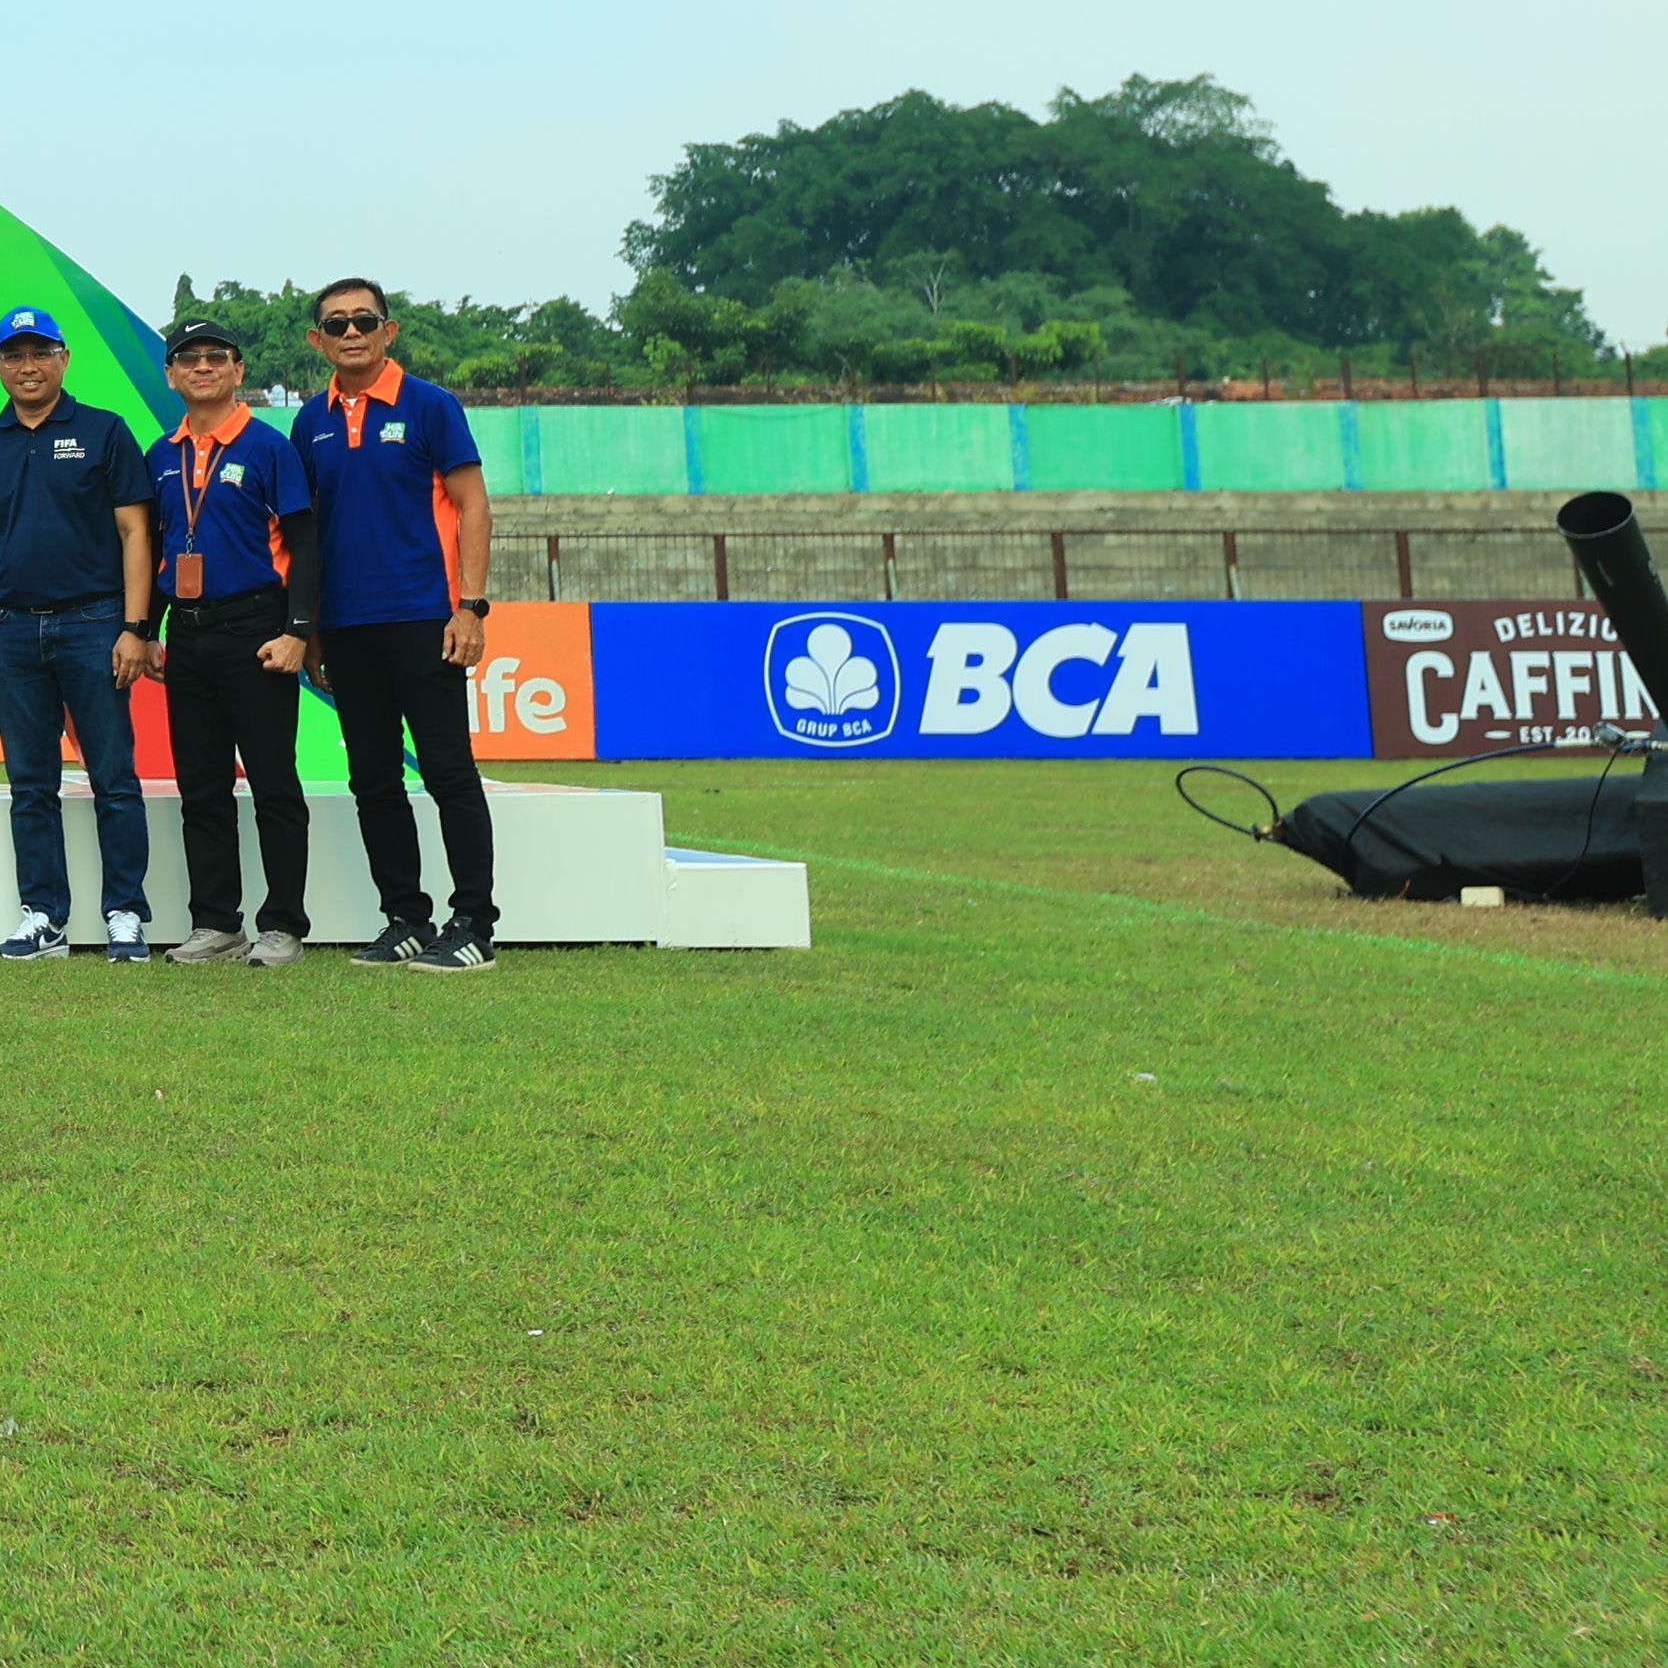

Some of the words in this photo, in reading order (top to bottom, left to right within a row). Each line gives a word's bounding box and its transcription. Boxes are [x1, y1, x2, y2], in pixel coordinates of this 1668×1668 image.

[54, 438, 77, 449] FIFA
[54, 452, 85, 460] FORWARD
[1390, 616, 1447, 630] SAVORIA
[919, 622, 1199, 738] BCA
[468, 657, 567, 734] ife
[1406, 651, 1660, 744] CAFFIN
[796, 718, 838, 738] GRUP
[843, 718, 872, 738] BCA
